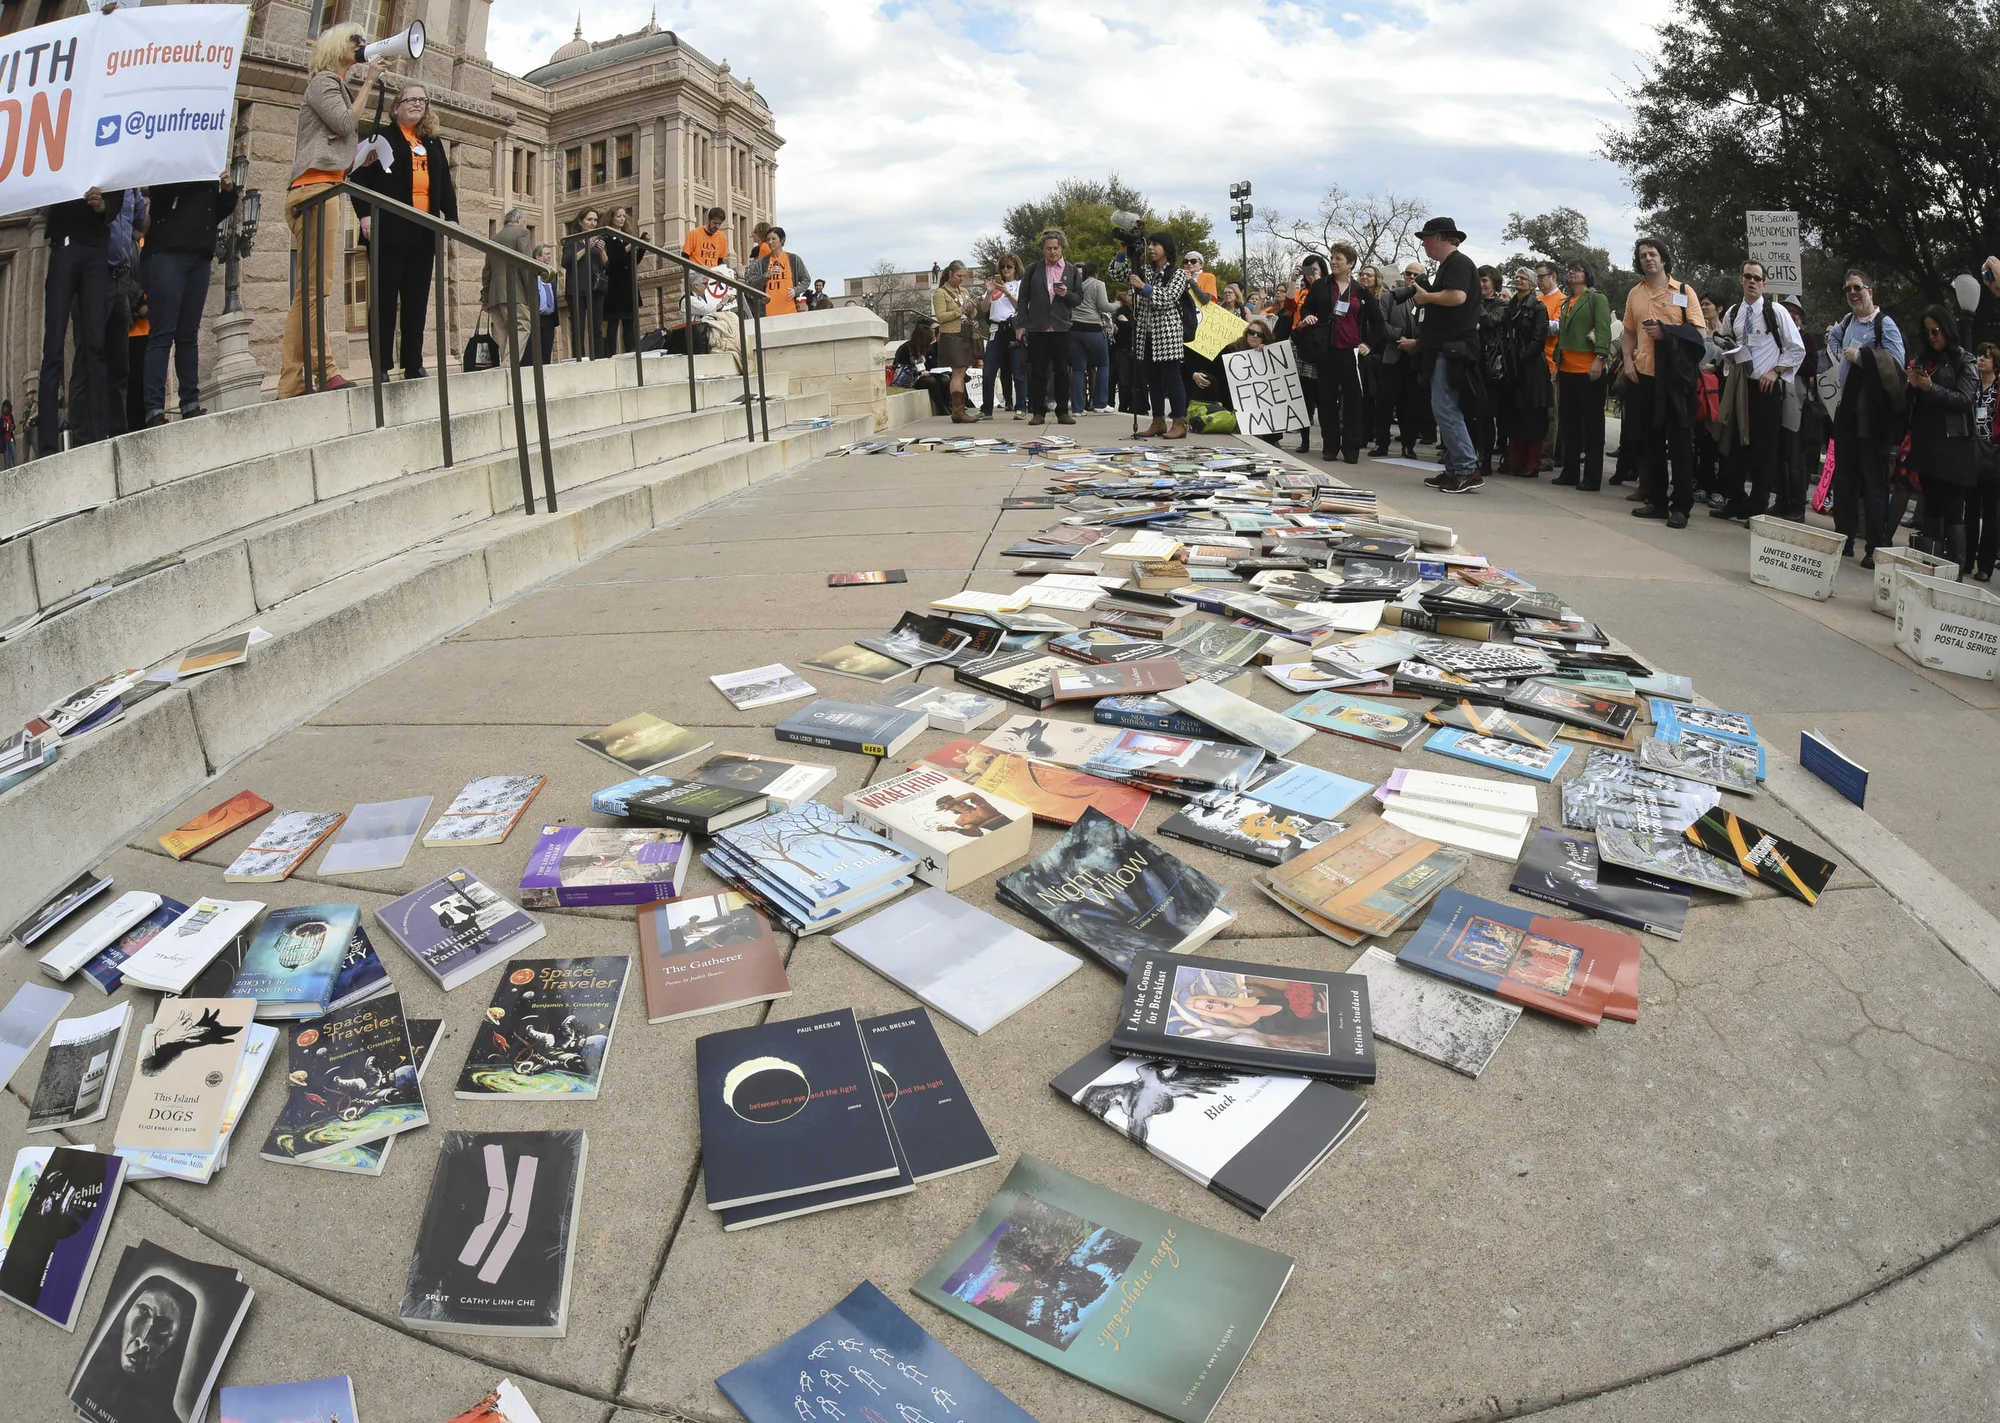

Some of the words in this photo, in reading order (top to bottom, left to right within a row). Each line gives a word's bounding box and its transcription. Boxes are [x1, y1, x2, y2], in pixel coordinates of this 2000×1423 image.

[106, 40, 234, 76] gunfreeut.org
[125, 107, 226, 140] @gunfreeut
[1750, 214, 1765, 223] THE
[1749, 226, 1798, 238] AMENDMENT
[701, 250, 717, 259] FREE
[1751, 252, 1765, 261] ALL
[1767, 251, 1792, 262] OTHER
[1766, 265, 1797, 281] GHTS
[768, 282, 781, 290] UT
[1229, 345, 1289, 381] GUN
[1236, 372, 1302, 412] FREE
[1249, 405, 1305, 435] MLA
[1759, 555, 1788, 570] POSTAL
[1790, 564, 1823, 579] SERVICE
[1763, 546, 1791, 561] UNITED
[1792, 553, 1822, 568] STATES
[1940, 623, 1968, 638] UNITED
[1970, 630, 1998, 644] STATES
[1934, 634, 1965, 649] POSTAL
[1966, 641, 1998, 656] SERVICE
[1121, 716, 1155, 727] STEPHENSON
[641, 783, 707, 805] HUMBOLDT
[854, 785, 879, 797] STORM
[857, 771, 948, 809] WRAETHTHU
[593, 800, 622, 814] HUMBOLDT
[800, 870, 830, 885] Out
[833, 861, 850, 872] of
[853, 850, 894, 869] Place
[1312, 865, 1336, 880] Cloud
[1037, 867, 1100, 907] Night
[1082, 851, 1148, 906] Willow
[1135, 916, 1152, 930] Luisa
[421, 926, 479, 957] William
[429, 928, 492, 966] Faulkner
[539, 967, 594, 978] Space
[662, 965, 686, 975] The
[690, 954, 742, 969] Gatherer
[542, 977, 618, 990] Traveler
[1137, 960, 1154, 993] Cosmos
[1149, 970, 1167, 1010] Breakfast
[1135, 994, 1145, 1008] the
[1350, 990, 1360, 1022] Studdard
[323, 1012, 373, 1034] Space
[1131, 1007, 1141, 1025] Ate
[1145, 1010, 1157, 1025] for
[328, 1015, 398, 1043] Traveler
[797, 1024, 813, 1034] PAUL
[814, 1020, 841, 1031] BRESLIN
[872, 1023, 889, 1034] PAUL
[889, 1020, 916, 1031] BRESLIN
[329, 1047, 359, 1062] Benjamin
[367, 1037, 401, 1049] Grossberg
[1353, 1024, 1364, 1056] Melissa
[154, 1092, 172, 1102] This
[174, 1094, 200, 1104] Island
[749, 1100, 780, 1110] between
[781, 1097, 792, 1106] my
[793, 1095, 806, 1103] eye
[810, 1090, 825, 1099] and
[826, 1088, 839, 1097] the
[839, 1084, 857, 1095] light
[898, 1087, 913, 1096] and
[913, 1084, 926, 1093] the
[926, 1079, 944, 1089] light
[148, 1108, 193, 1122] DOGS
[1203, 1094, 1237, 1121] Black
[150, 1152, 168, 1161] Judith
[169, 1157, 188, 1166] Austin
[188, 1161, 204, 1169] Mills
[75, 1182, 103, 1199] child
[73, 1199, 98, 1208] sings
[1150, 1228, 1180, 1269] magic
[425, 1293, 449, 1303] SPLIT
[460, 1296, 490, 1307] CATHY
[493, 1297, 514, 1307] LINH
[516, 1298, 536, 1307] CHE
[1182, 1381, 1200, 1406] POEMS
[1199, 1369, 1208, 1381] BY
[1206, 1352, 1219, 1369] AMY
[1216, 1324, 1236, 1352] FLEURY
[84, 1397, 98, 1411] THE
